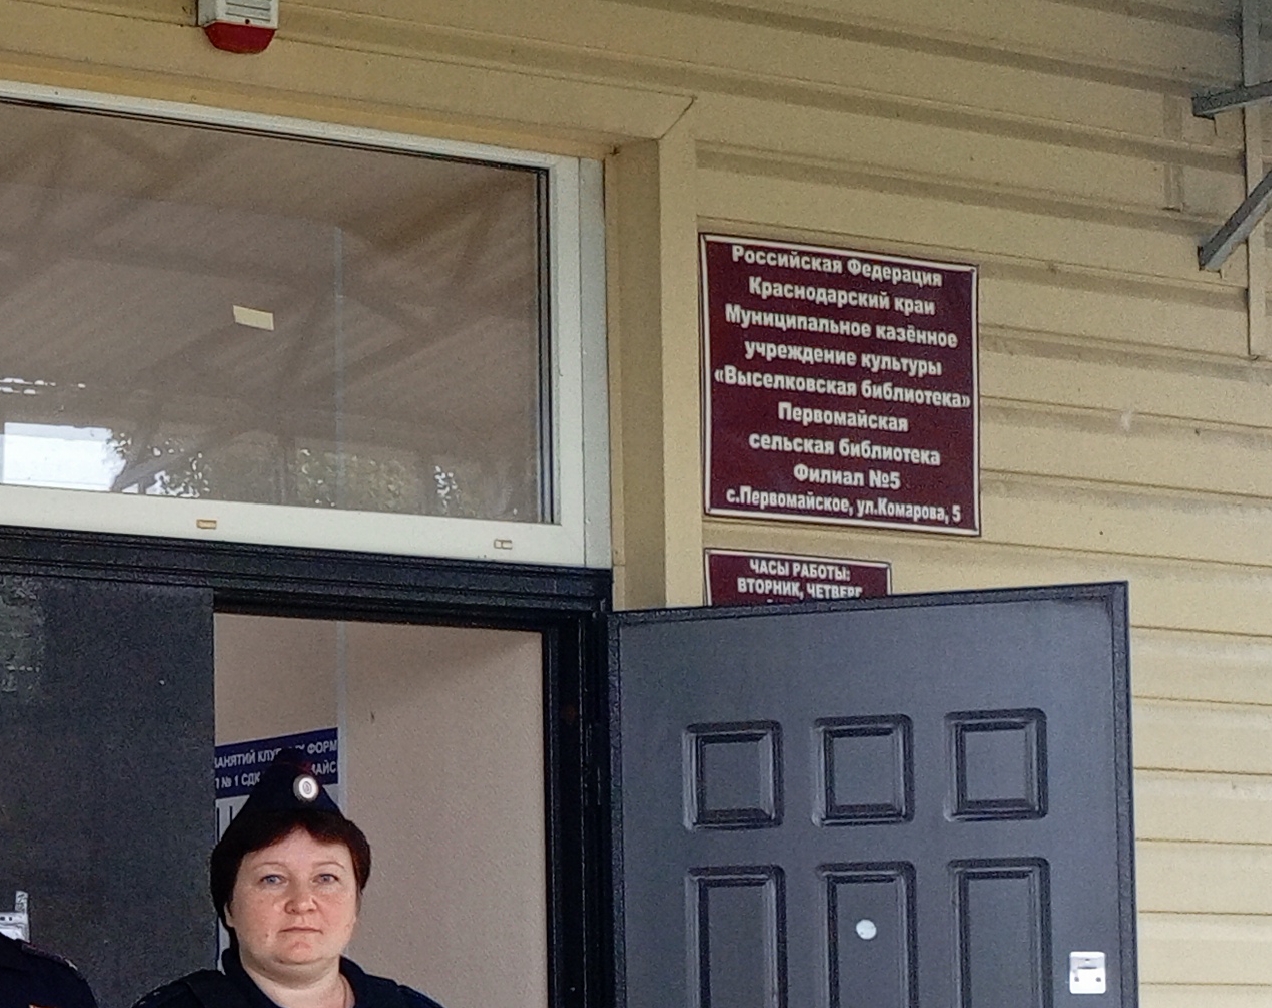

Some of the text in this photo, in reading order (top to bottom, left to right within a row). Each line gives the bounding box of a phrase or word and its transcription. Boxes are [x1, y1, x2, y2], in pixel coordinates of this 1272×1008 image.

[731, 245, 943, 288] Российская Федерация
[749, 277, 890, 309] Краснодарский
[725, 303, 958, 349] Муниципальное казённое
[744, 340, 942, 378] учреждение культуры
[714, 364, 971, 409] «Выселковская библиотека»
[778, 401, 909, 433] Первомайская
[748, 433, 941, 466] сельская библиотека
[793, 463, 901, 490] Филиал №5
[726, 485, 961, 525] с.Первомайское, ул.Комарова, 5
[750, 559, 851, 582] ЧАСЫ РАБОТЫ:
[737, 577, 863, 600] ВТОРНИК, ЧЕТВЕРГ
